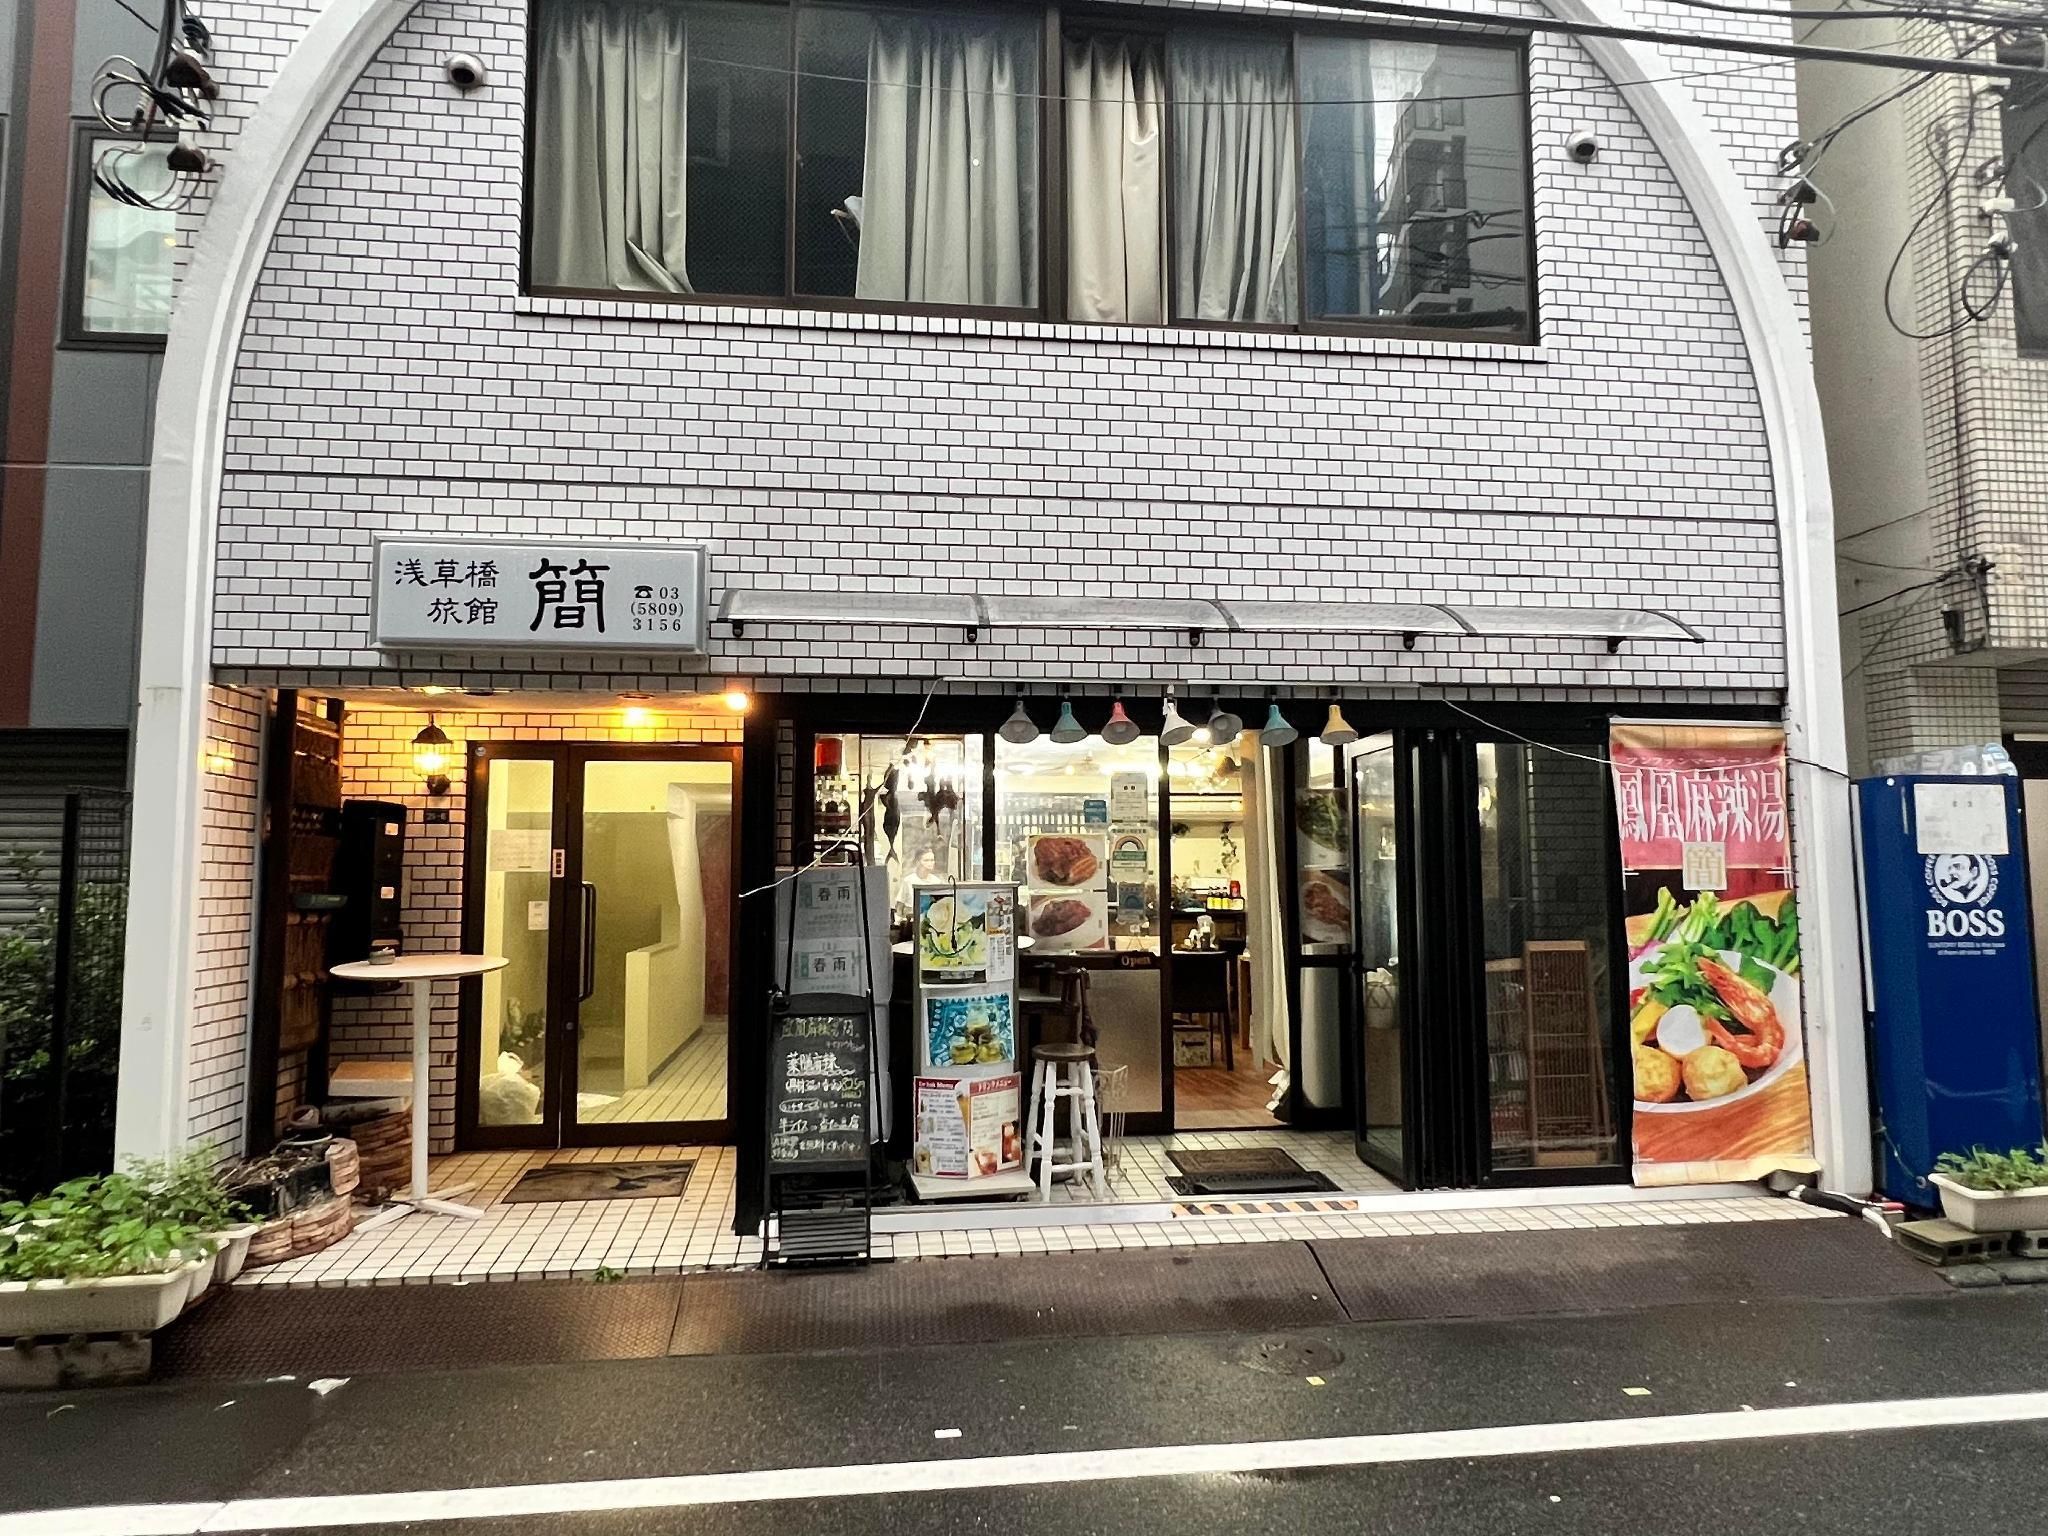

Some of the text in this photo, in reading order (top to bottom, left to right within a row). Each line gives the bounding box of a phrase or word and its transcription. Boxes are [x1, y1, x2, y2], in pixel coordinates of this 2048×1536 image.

[394, 558, 500, 589] 浅草橋
[529, 557, 611, 633] 簡
[659, 587, 680, 600] 03
[427, 597, 498, 626] 旅館
[630, 601, 684, 617] (5809)
[633, 617, 682, 632] 3156
[1611, 768, 1786, 843] 鳳凰麻辣湯
[1926, 909, 2005, 936] BOSS
[814, 956, 846, 972] 春雨
